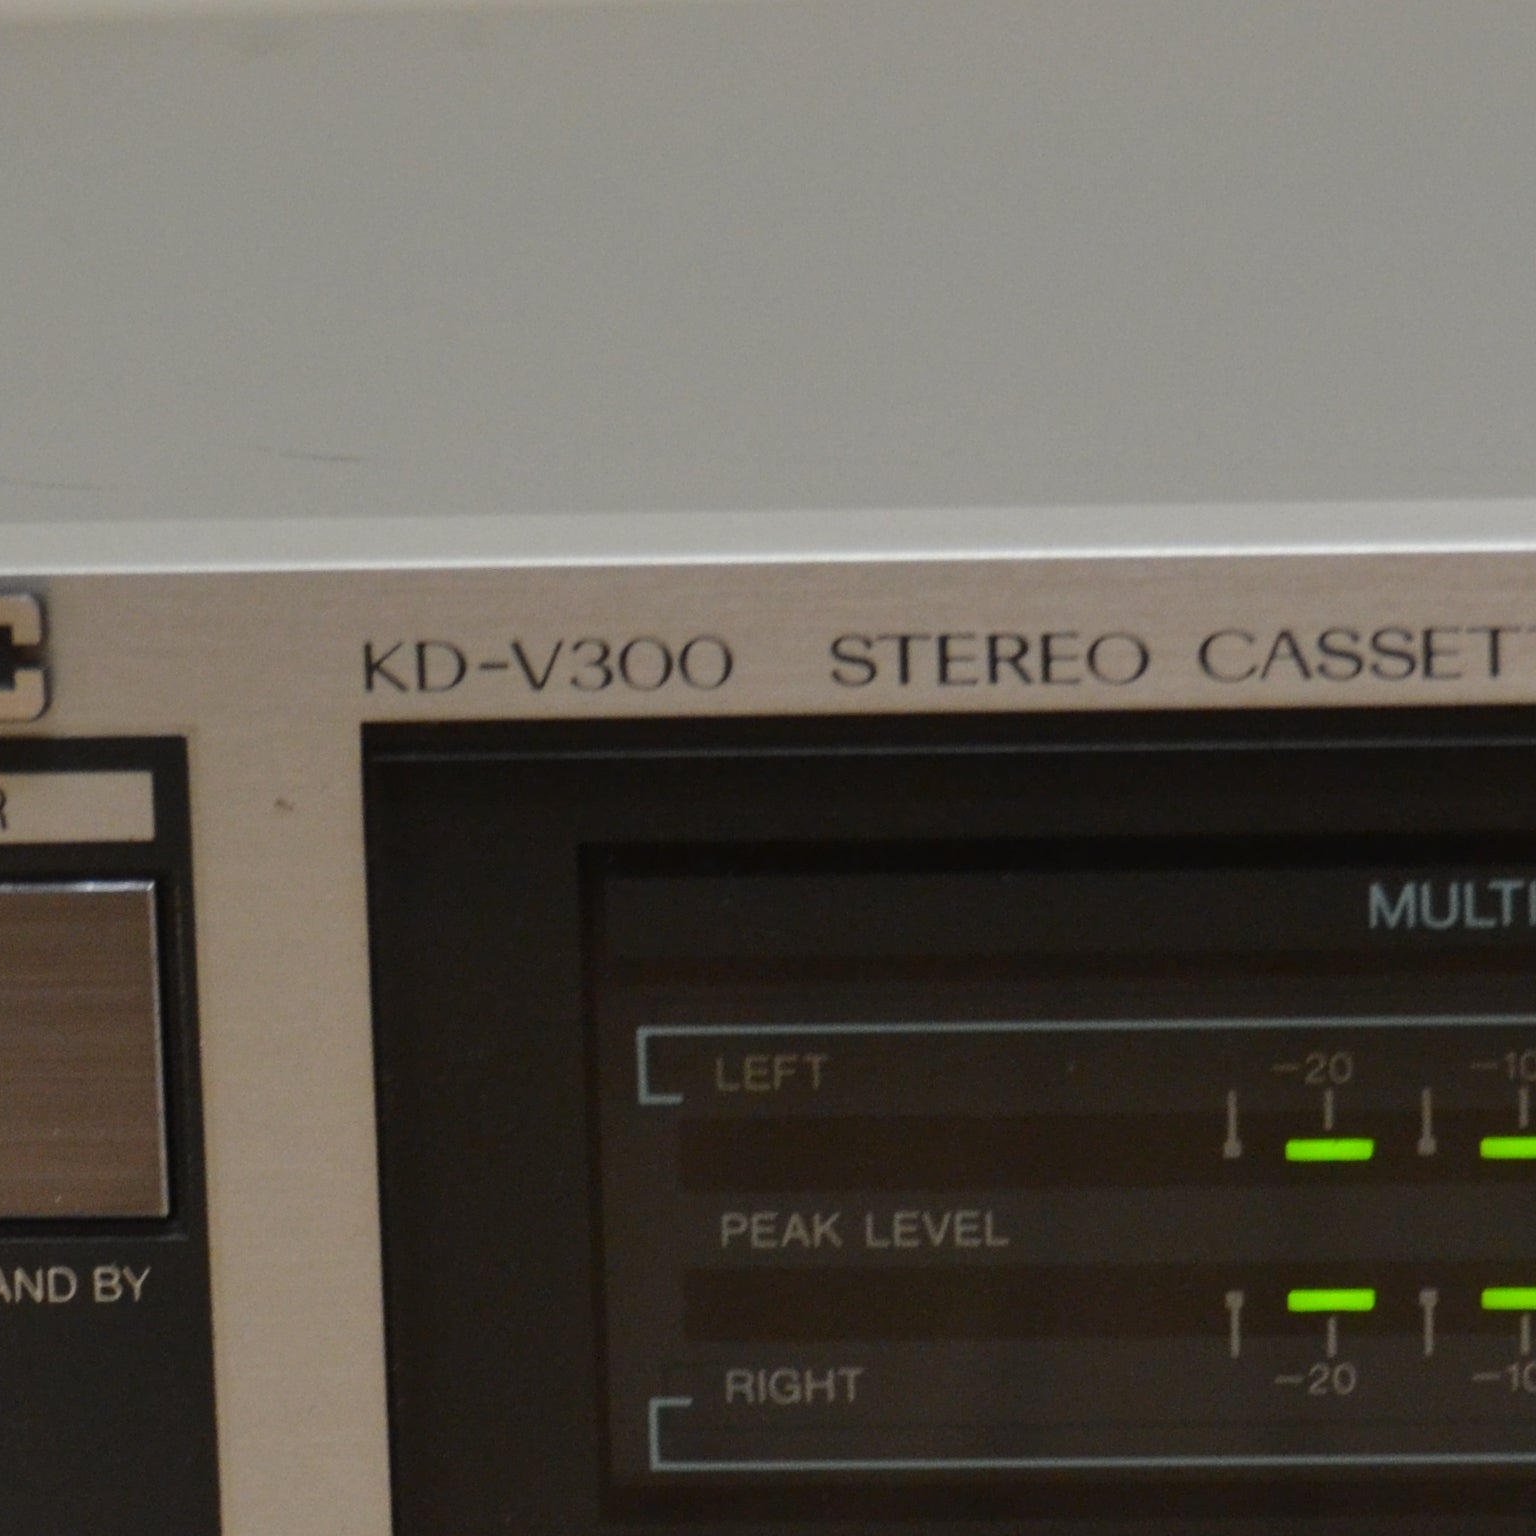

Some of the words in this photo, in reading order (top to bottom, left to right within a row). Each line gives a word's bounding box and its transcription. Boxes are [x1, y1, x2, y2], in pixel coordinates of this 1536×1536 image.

[360, 636, 736, 694] KD-V300
[828, 630, 1152, 688] STEREO
[714, 1053, 830, 1093] LEFT
[720, 1210, 842, 1250] PEAK
[864, 1208, 1010, 1248] LEVEL
[92, 1266, 150, 1302] BY
[724, 1366, 864, 1404] RIGHT
